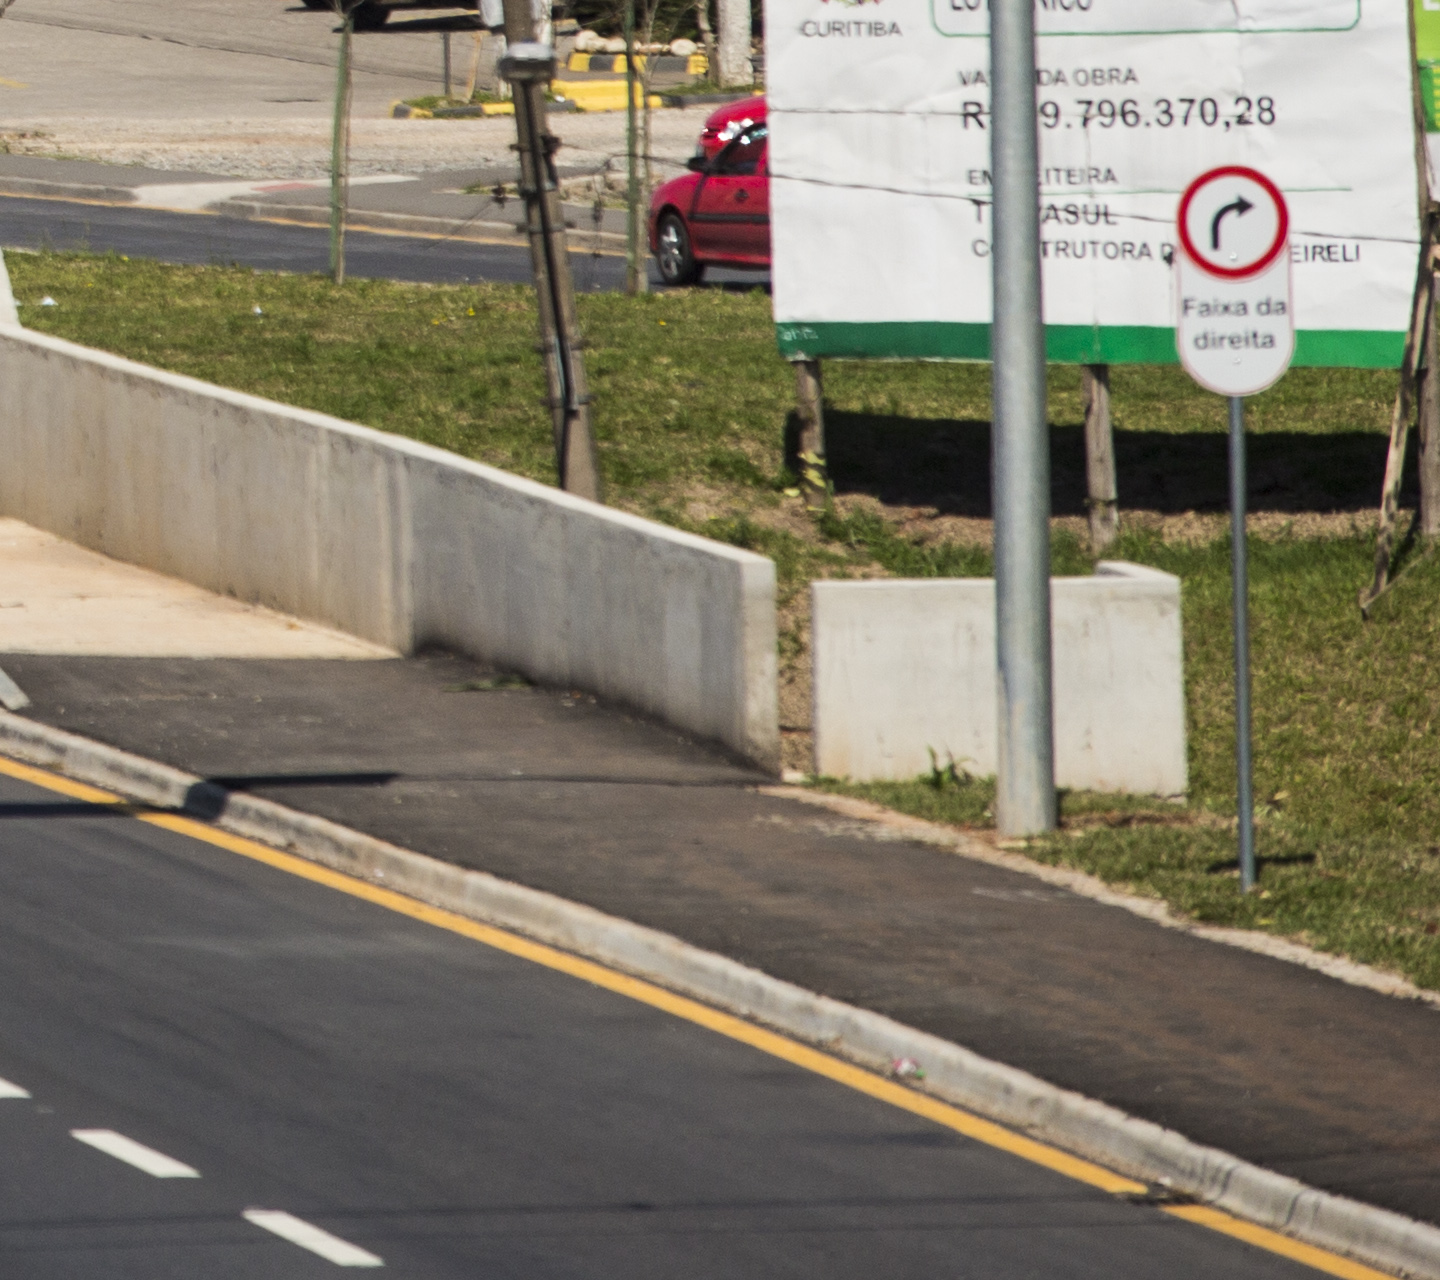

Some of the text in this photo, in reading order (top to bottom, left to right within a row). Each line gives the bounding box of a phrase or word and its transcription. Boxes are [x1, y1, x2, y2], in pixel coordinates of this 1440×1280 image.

[801, 20, 903, 38] CURITIBA
[1074, 68, 1139, 86] OBRA
[1039, 95, 1277, 133] 9.796.370,28
[1181, 295, 1287, 318] Faixa da
[1192, 328, 1277, 352] direita
